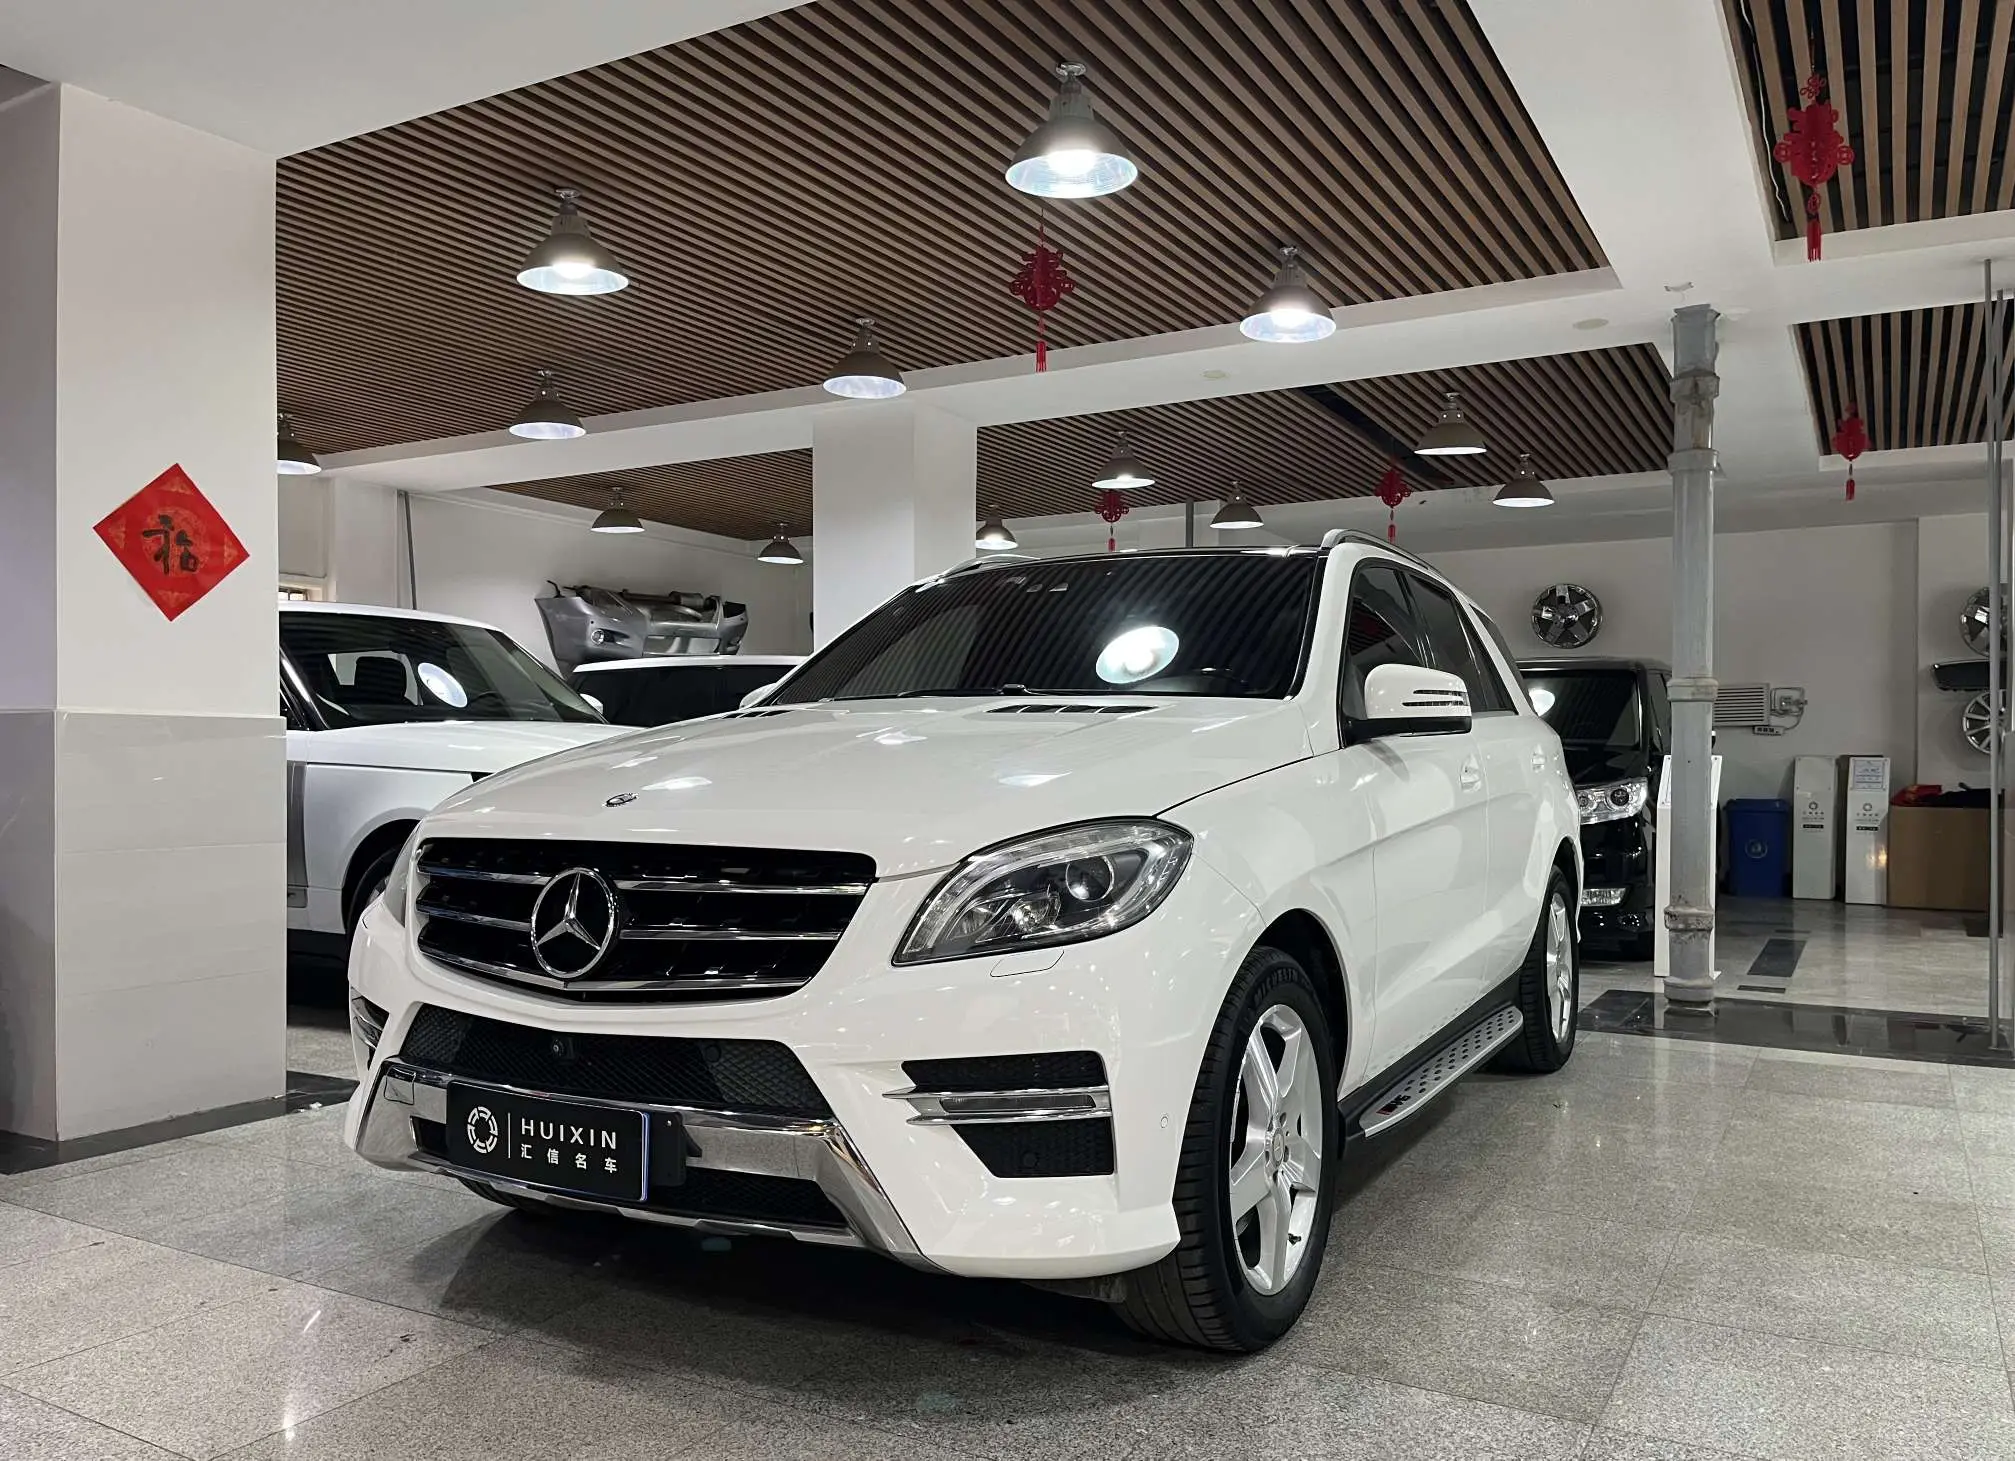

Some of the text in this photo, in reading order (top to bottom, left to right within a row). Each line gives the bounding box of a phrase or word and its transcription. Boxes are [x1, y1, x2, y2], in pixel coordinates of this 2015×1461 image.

[142, 514, 200, 575] 福
[521, 1117, 617, 1150] HUIXIN
[520, 1143, 618, 1174] 汇信名车
